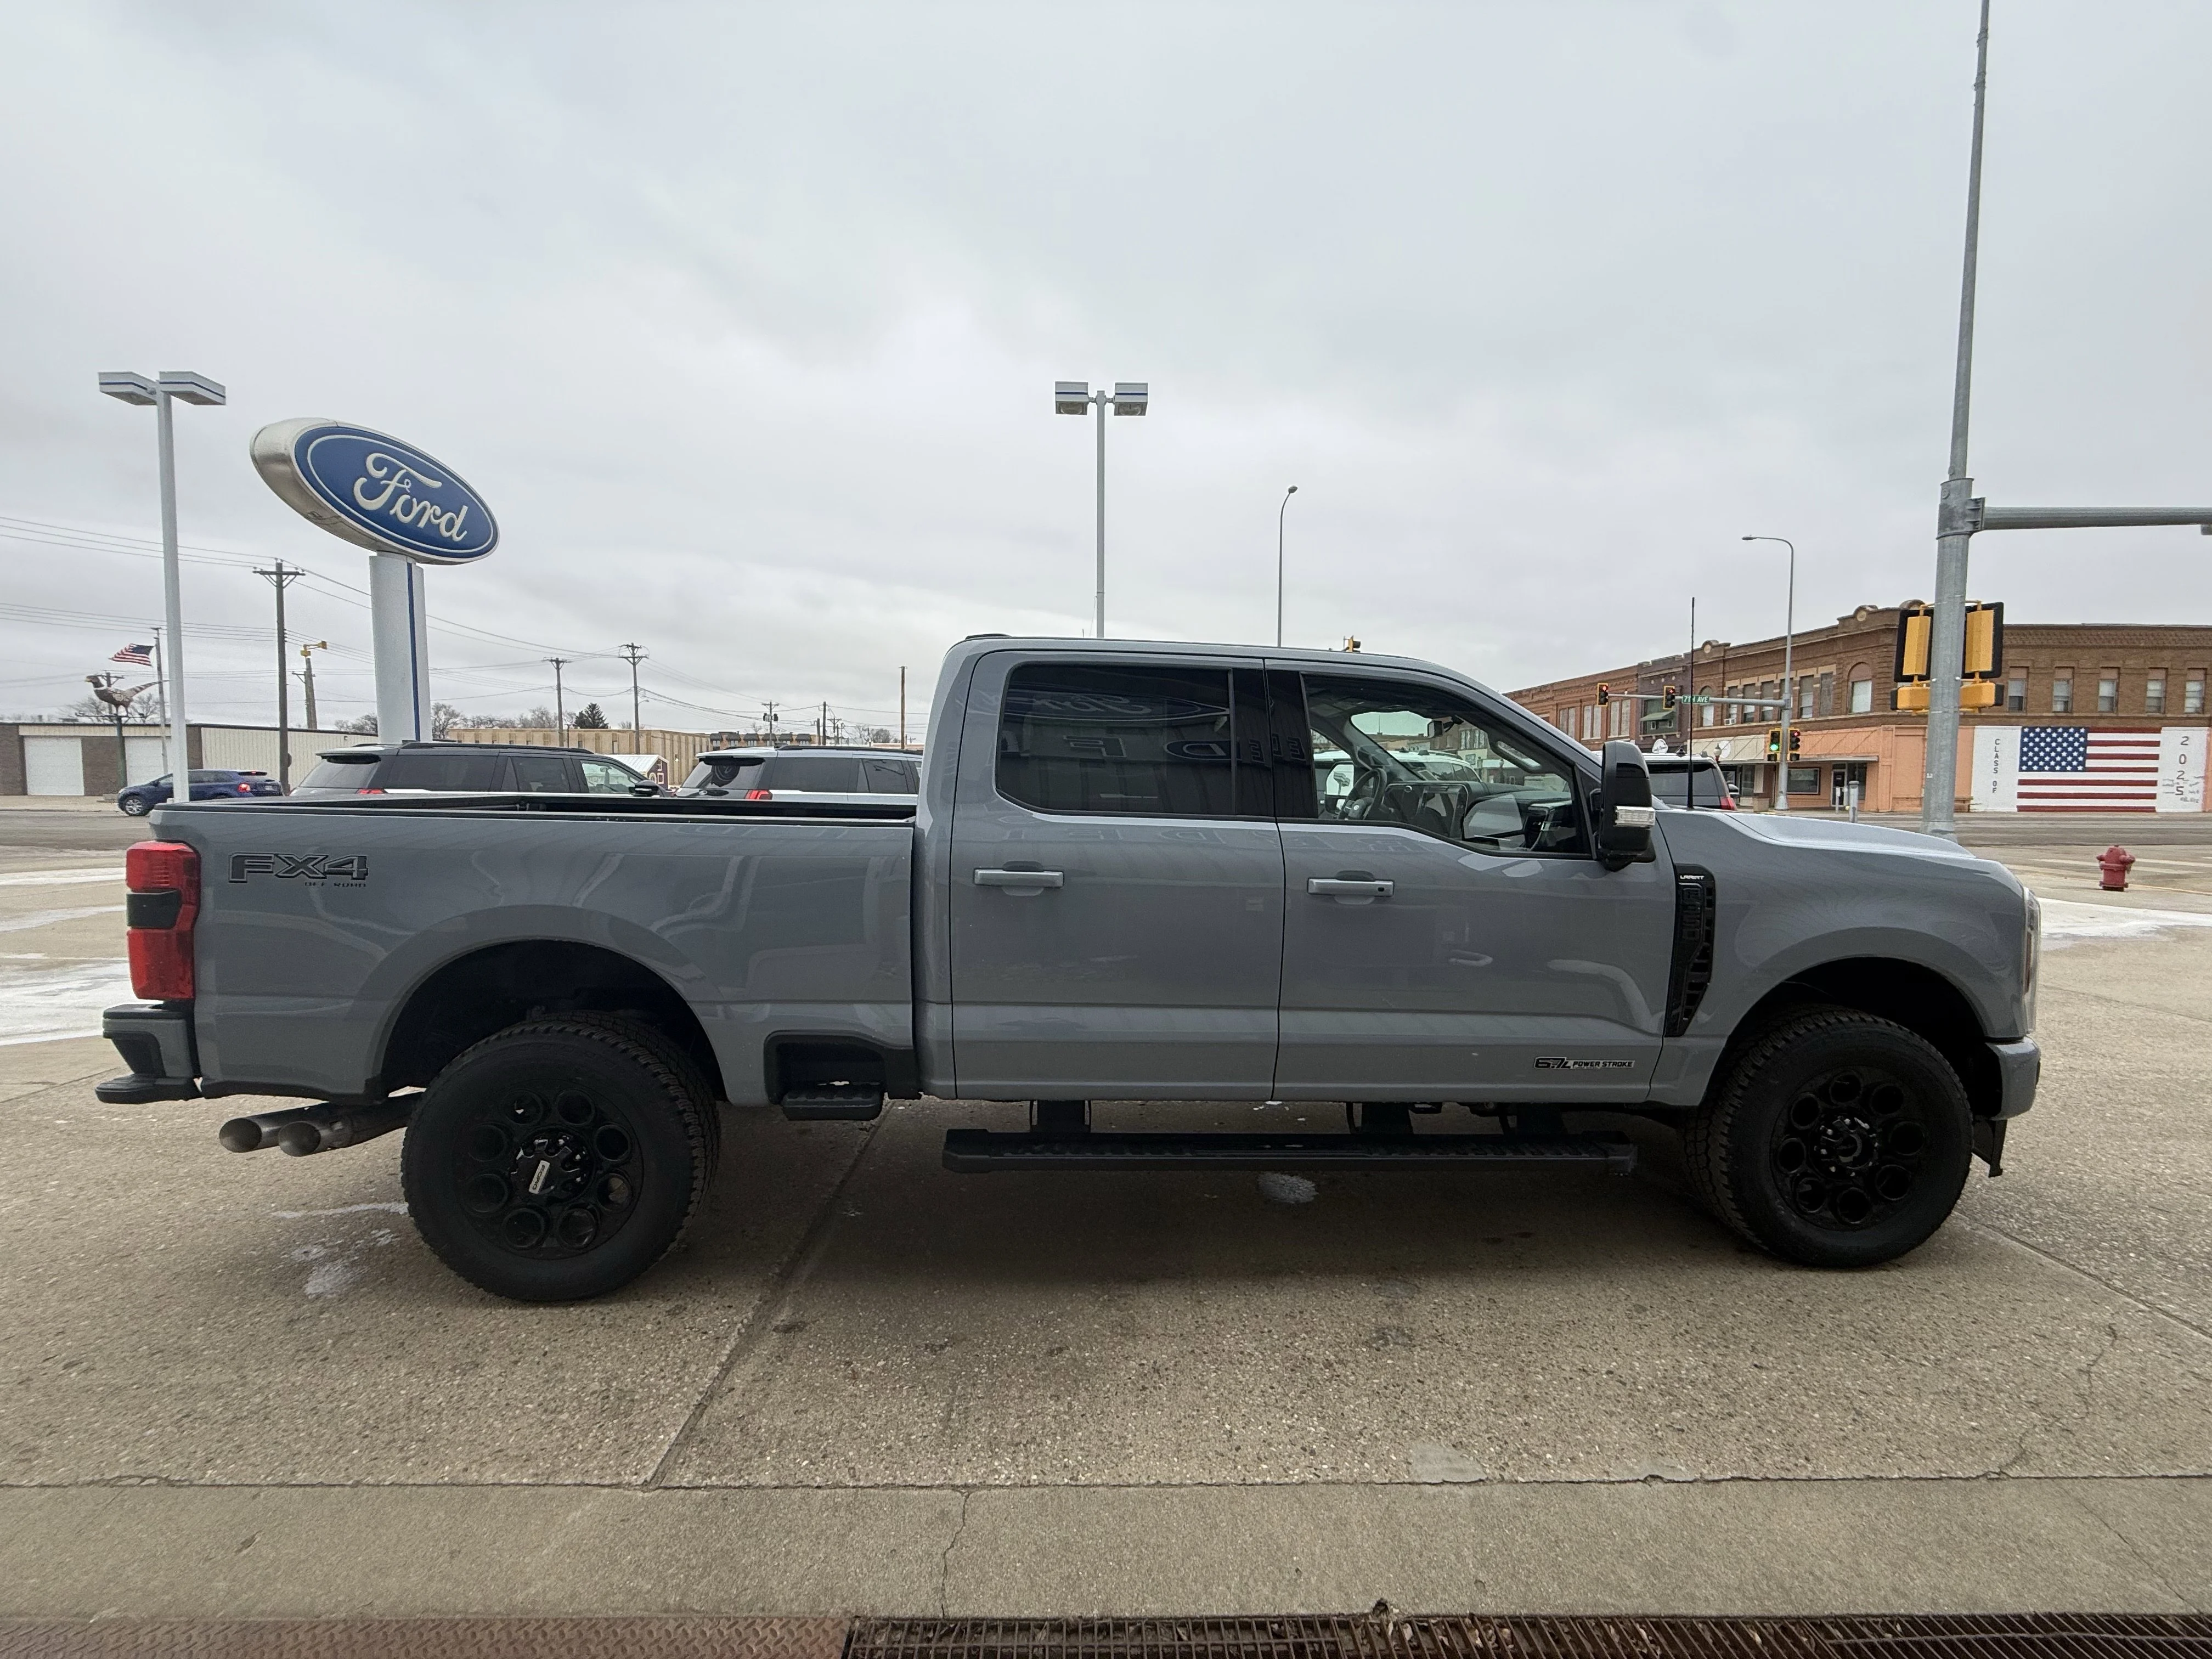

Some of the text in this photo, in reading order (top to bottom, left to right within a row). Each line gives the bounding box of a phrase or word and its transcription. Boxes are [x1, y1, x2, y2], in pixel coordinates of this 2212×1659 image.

[353, 453, 468, 542] Ford
[1992, 738, 2001, 793] CLASS OF
[2175, 736, 2190, 795] 2025
[228, 852, 369, 883] FX4
[532, 1164, 545, 1190] FORD
